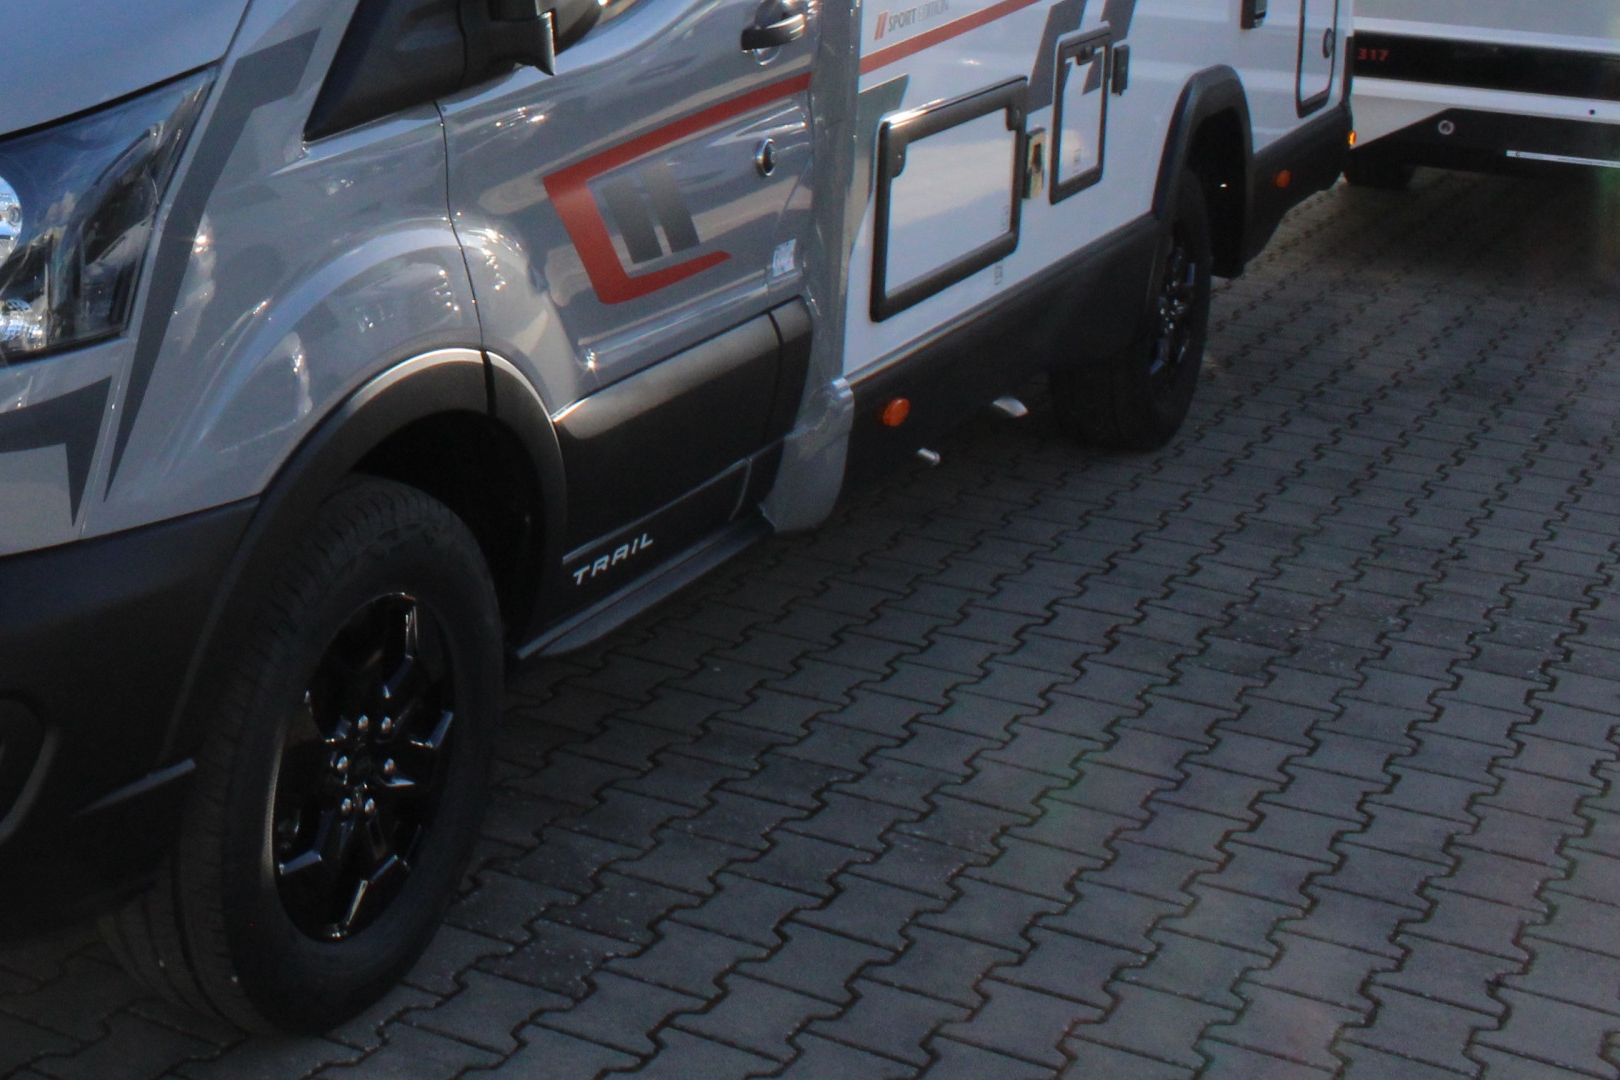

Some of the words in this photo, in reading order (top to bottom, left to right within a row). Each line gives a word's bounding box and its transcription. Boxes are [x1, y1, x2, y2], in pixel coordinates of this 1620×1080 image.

[888, 8, 917, 32] SPORT
[1357, 48, 1390, 62] 317
[573, 532, 654, 586] TRAIL
